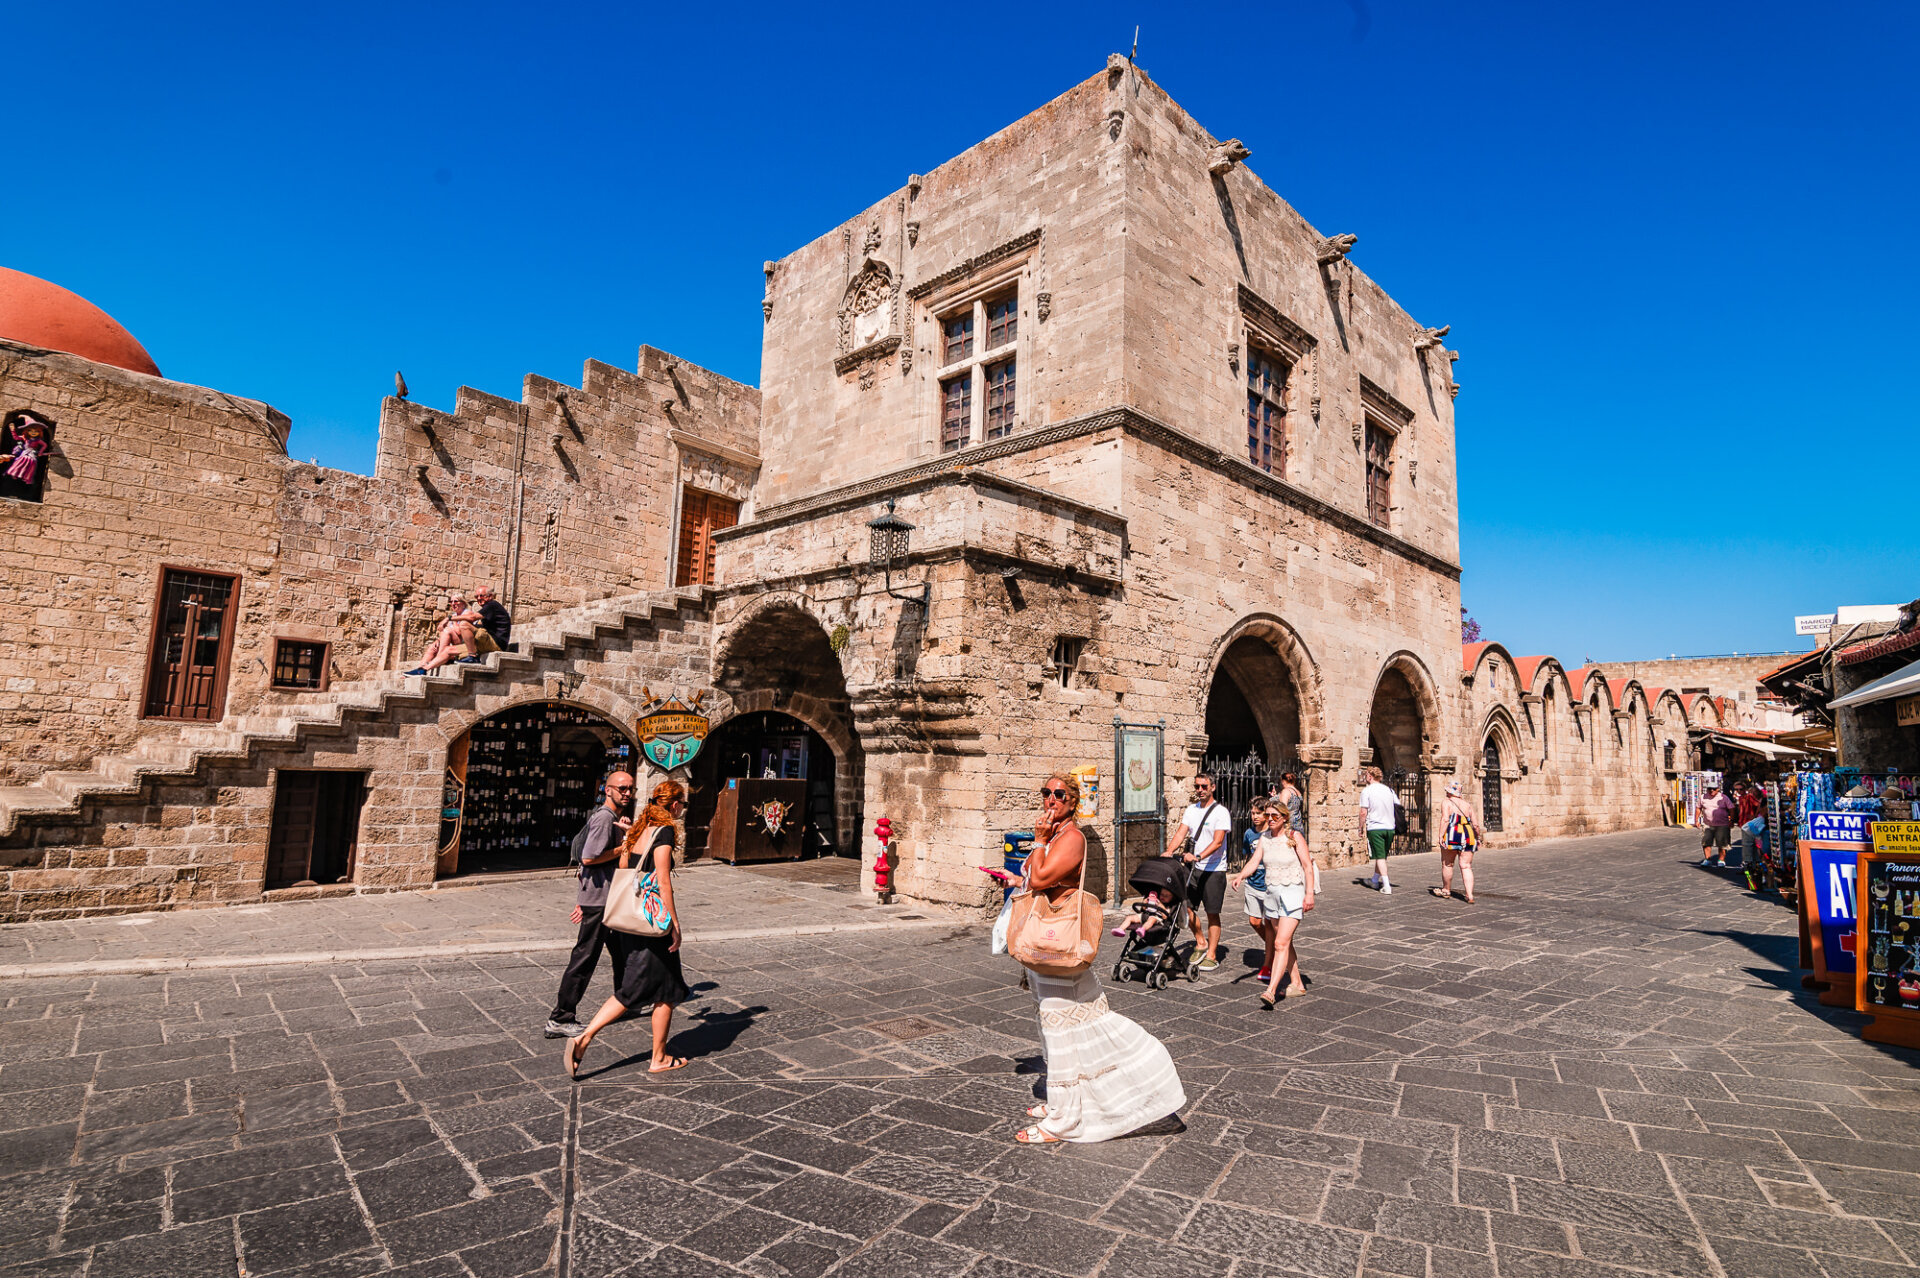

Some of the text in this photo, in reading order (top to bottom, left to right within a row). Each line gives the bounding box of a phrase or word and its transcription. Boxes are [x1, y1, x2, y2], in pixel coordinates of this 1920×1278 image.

[1814, 815, 1862, 828] ATM
[1876, 825, 1901, 833] ROOF
[1815, 829, 1863, 840] HERE
[1886, 834, 1920, 842] ENTRA
